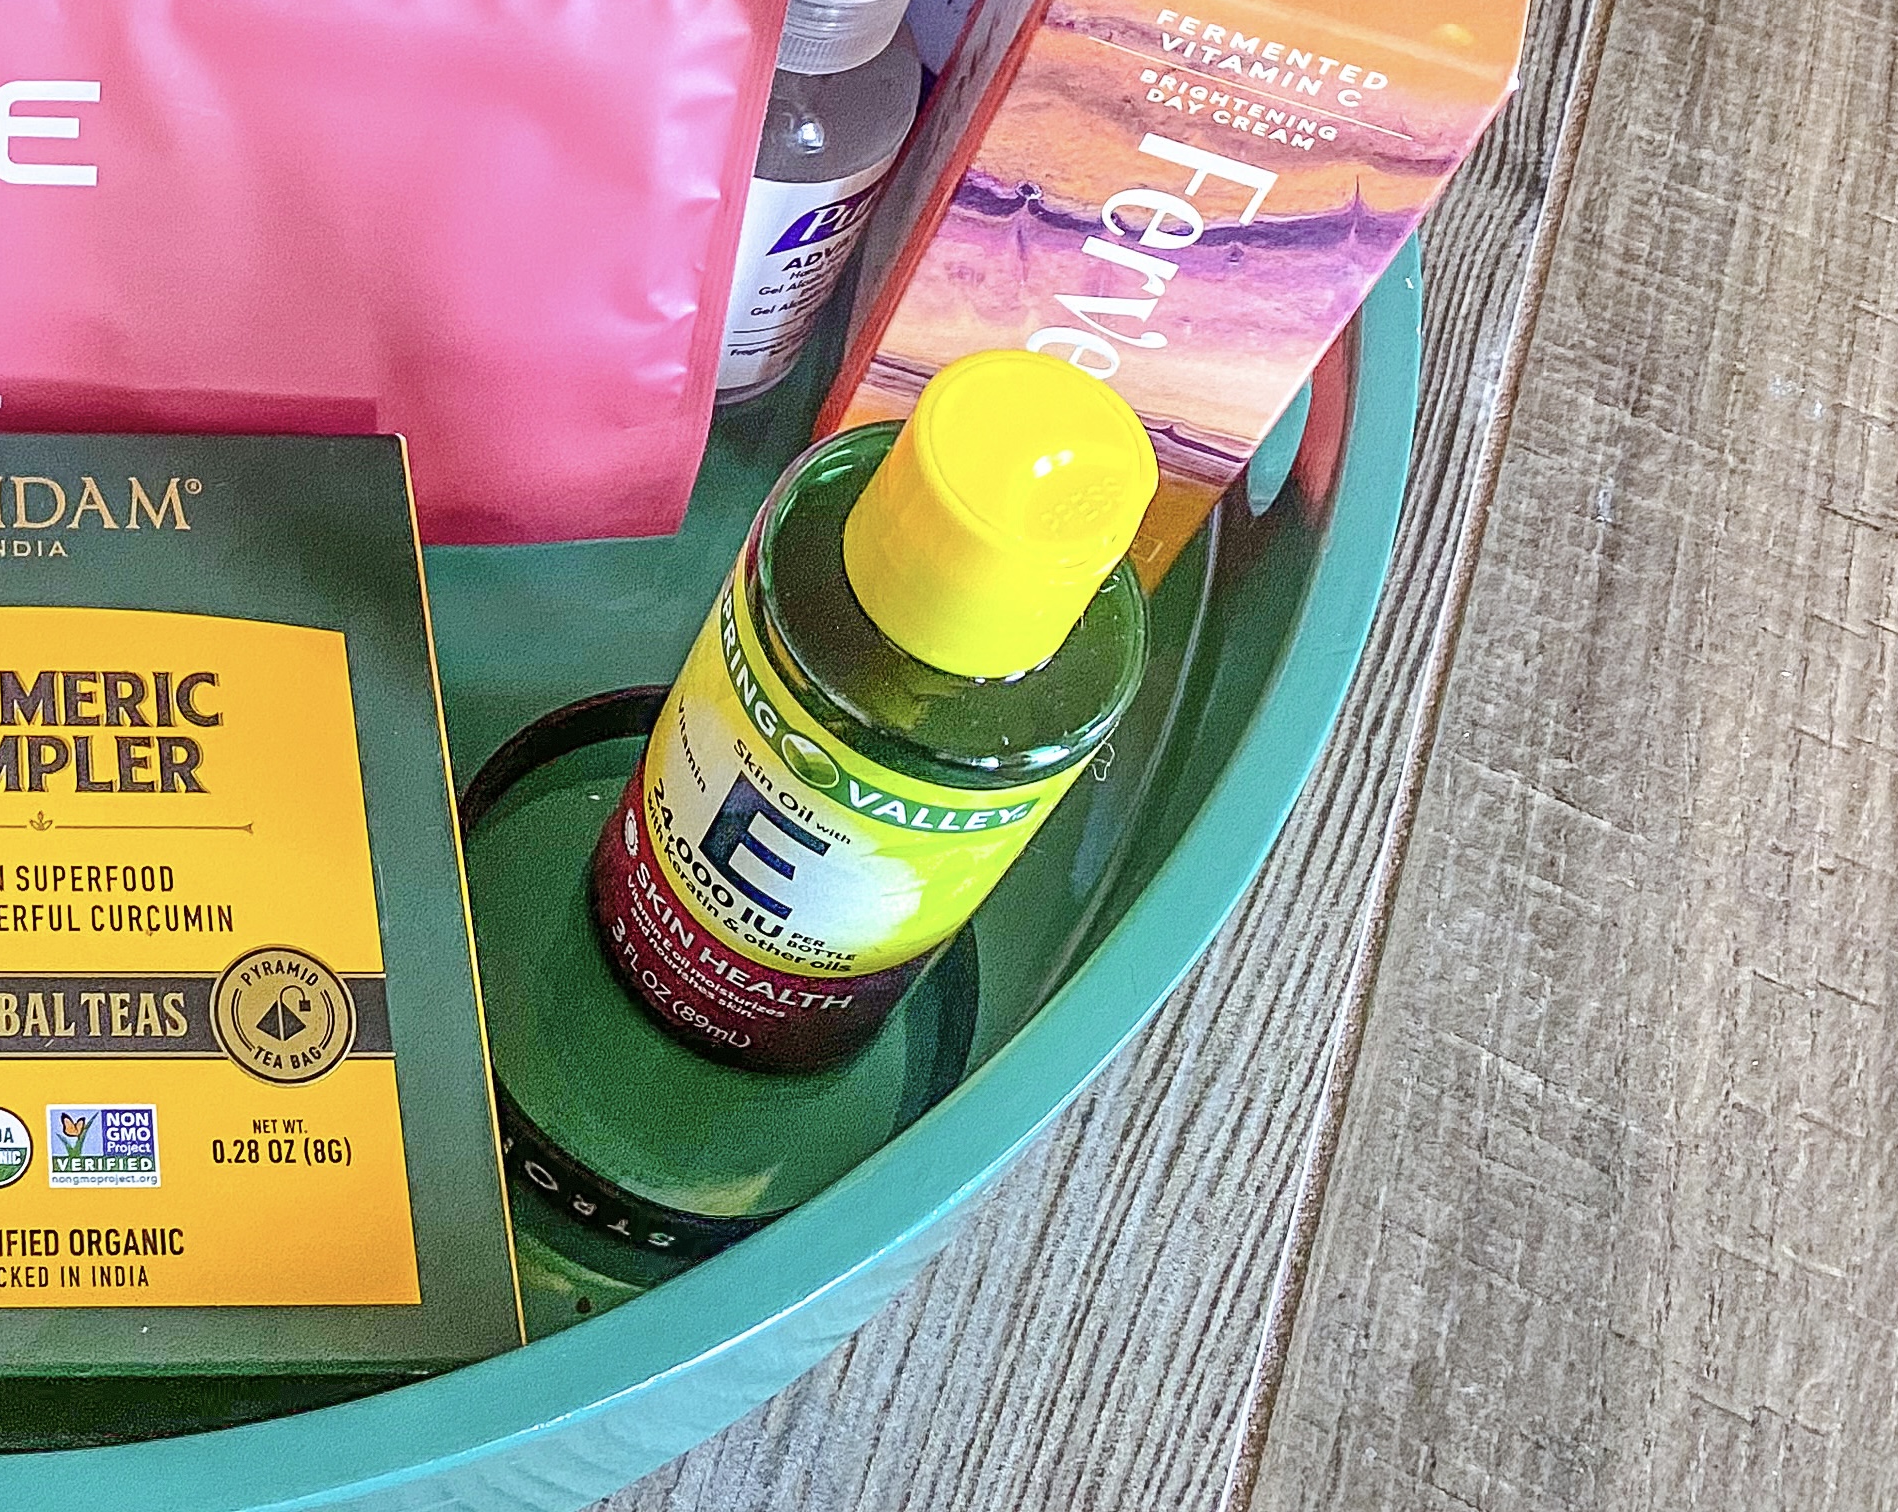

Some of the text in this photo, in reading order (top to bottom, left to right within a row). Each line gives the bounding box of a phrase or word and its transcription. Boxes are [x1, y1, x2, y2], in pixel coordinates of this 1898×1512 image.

[1154, 7, 1391, 93] FERMENTED
[1160, 32, 1366, 110] VITAMIN C
[1137, 68, 1341, 142] BRIGHTENING
[1143, 87, 1318, 153] DAY CREAM
[733, 738, 852, 846] Skin Oil with
[698, 770, 831, 921] E
[16, 865, 176, 893] SUPERFOOD
[90, 904, 234, 934] CURCUMIN
[740, 906, 784, 939] IU
[636, 862, 853, 1010] SKIN HEALTH
[744, 933, 807, 965] other
[239, 959, 321, 988] PYRAMID
[612, 916, 627, 943] 3
[642, 970, 674, 1004] OZ
[81, 991, 189, 1038] TEAS
[253, 1042, 324, 1070] TEA BAG
[106, 1112, 149, 1127] NON
[106, 1127, 151, 1142] GMO
[252, 1118, 309, 1135] NET WT.
[107, 1142, 151, 1155] Project
[211, 1136, 353, 1168] 0.28 OZ (8G)
[56, 1157, 153, 1172] VERIFIED
[52, 1175, 158, 1186] nongmoproject.org
[68, 1229, 184, 1257] ORGANIC
[59, 1265, 80, 1288] IN
[91, 1265, 150, 1288] INDIA
